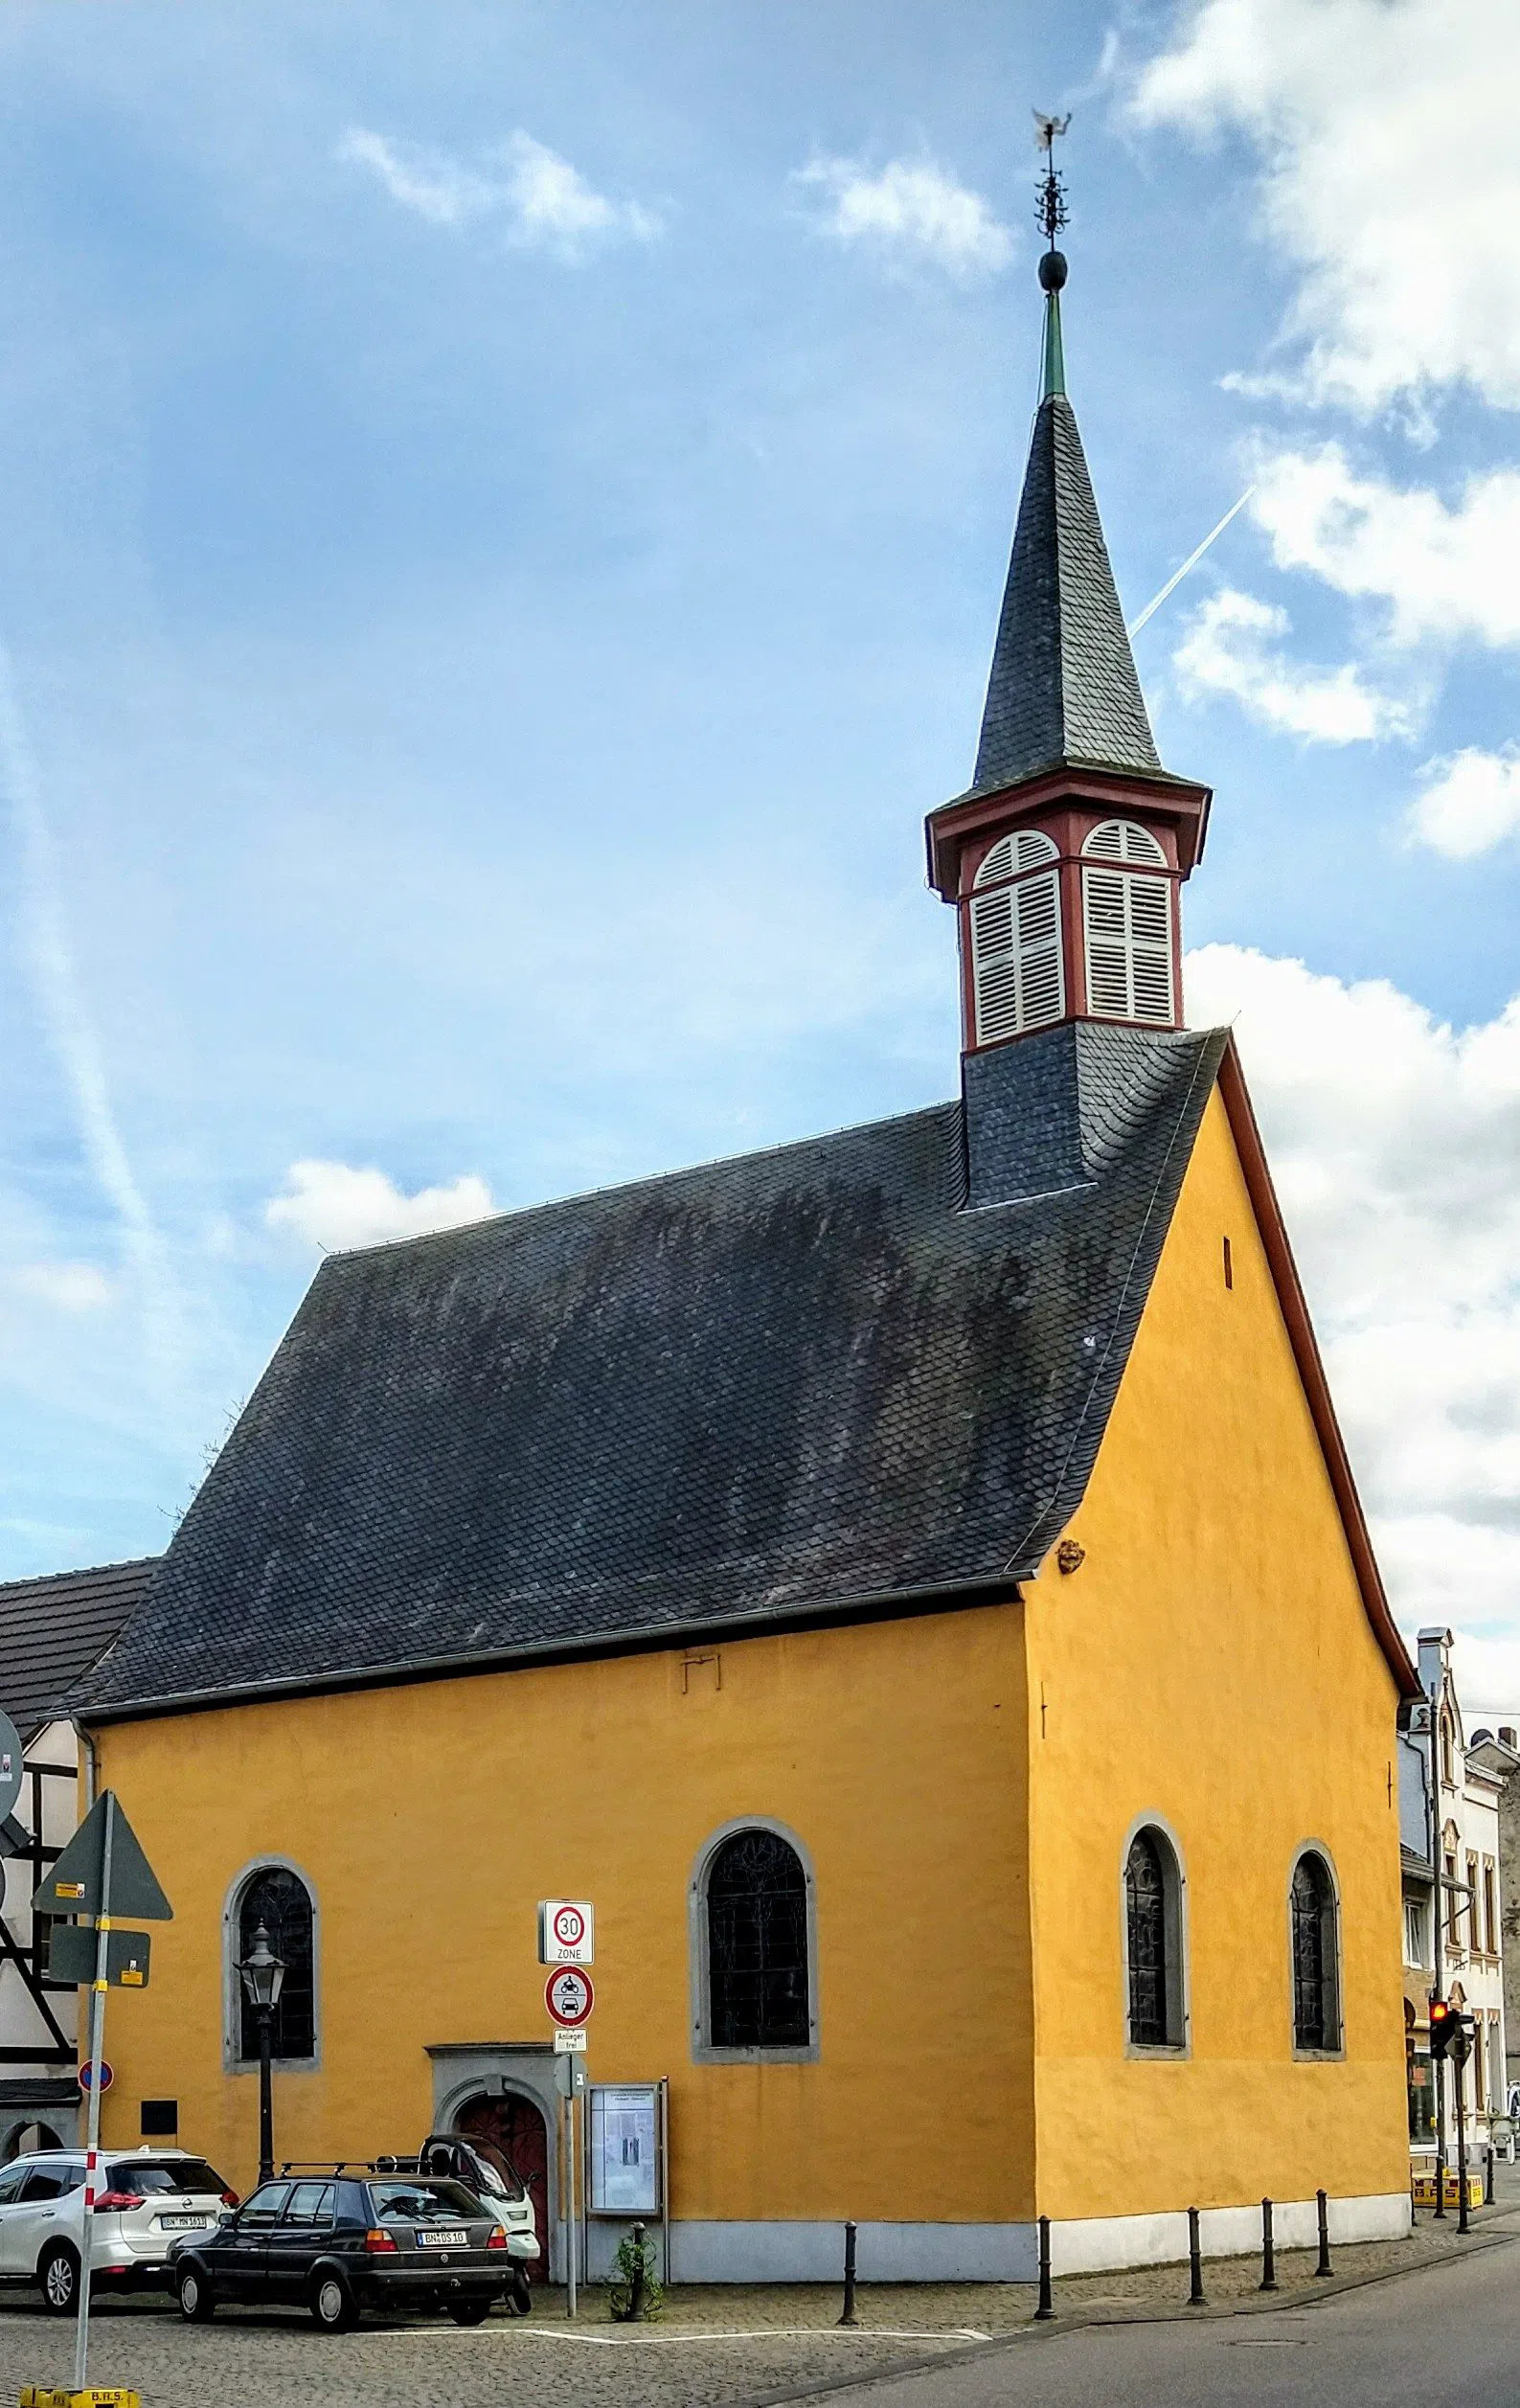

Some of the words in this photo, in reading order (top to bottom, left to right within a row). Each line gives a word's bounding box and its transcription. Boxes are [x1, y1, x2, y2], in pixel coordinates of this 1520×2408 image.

[560, 1918, 579, 1936] 30
[557, 1948, 582, 1960] ZONE
[566, 2041, 577, 2050] frei
[425, 2234, 437, 2243] BN
[442, 2233, 452, 2242] DS
[453, 2232, 464, 2242] 10
